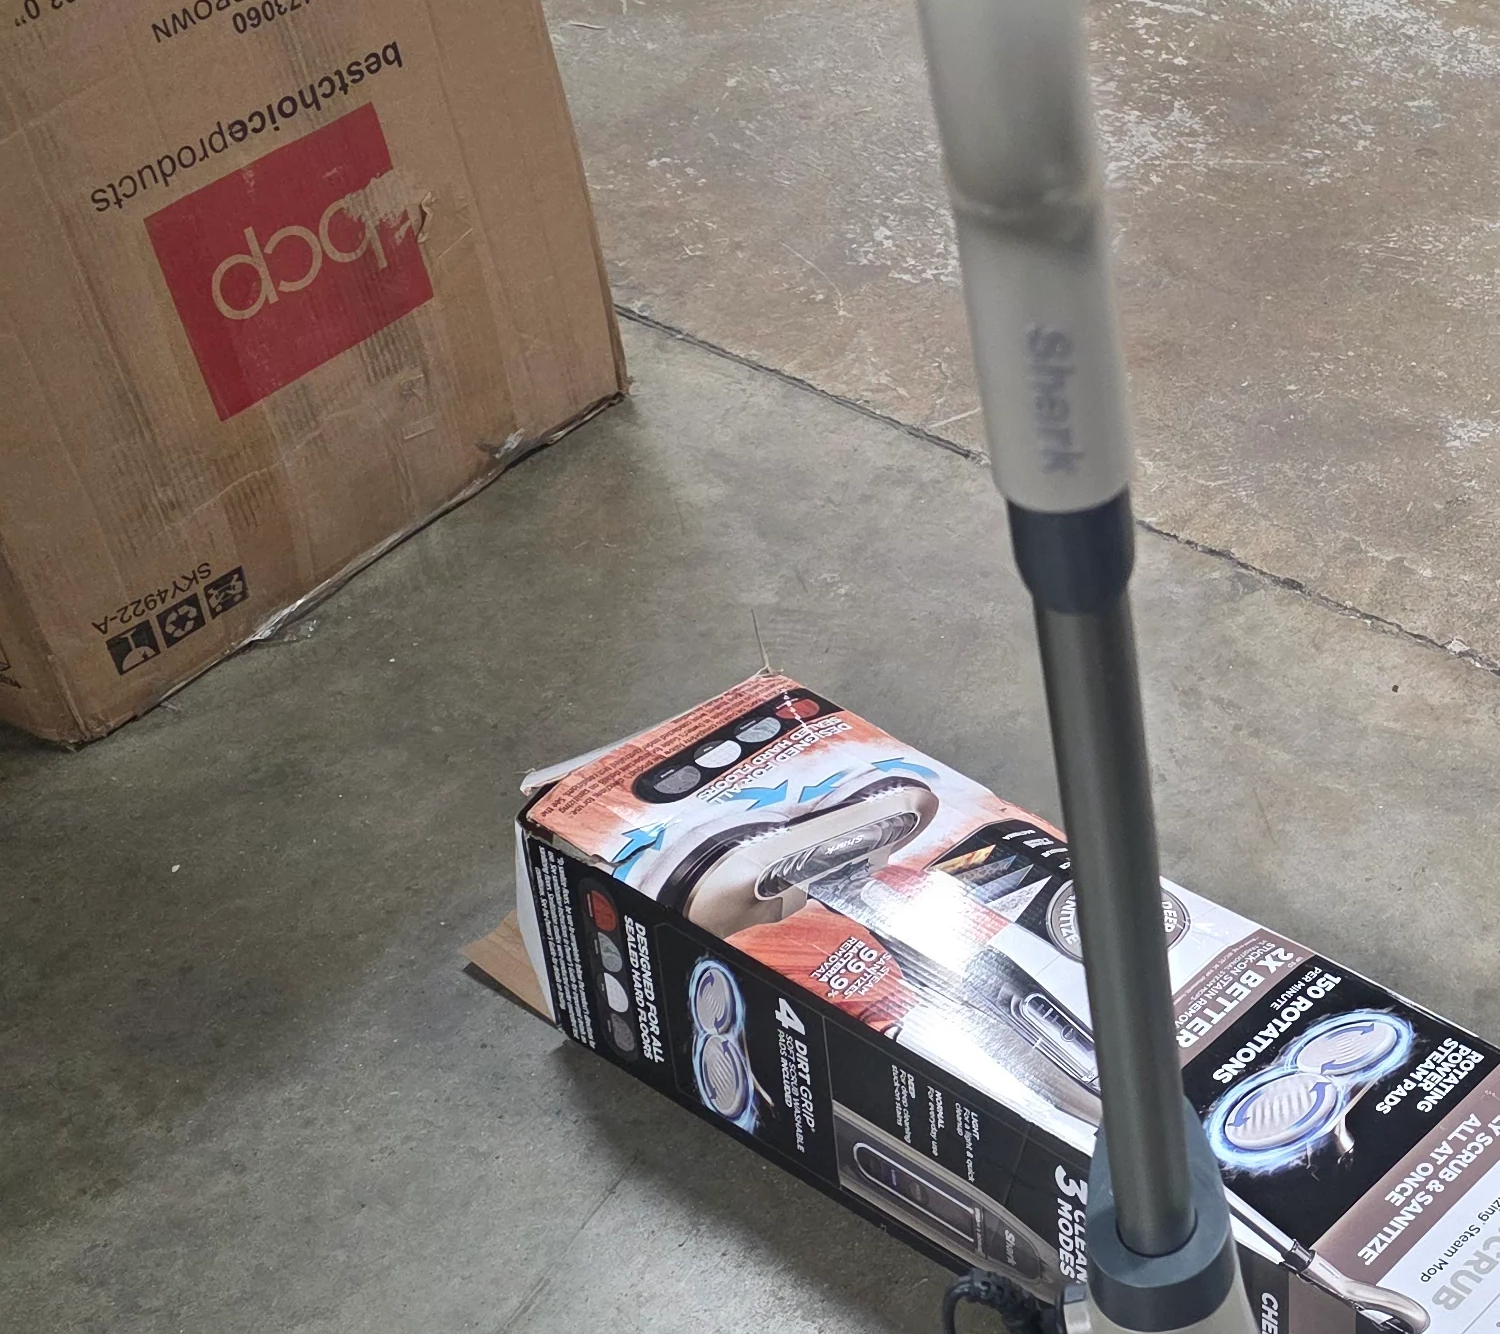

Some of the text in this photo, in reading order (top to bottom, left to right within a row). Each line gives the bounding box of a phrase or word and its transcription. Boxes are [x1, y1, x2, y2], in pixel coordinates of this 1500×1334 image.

[90, 41, 403, 212] bestchoiceproducts
[1023, 327, 1085, 473] Shark
[91, 562, 212, 635] SKY4922-A
[749, 737, 791, 768] HARD
[773, 720, 854, 765] DESIGNED
[695, 763, 751, 801] FLOORS
[706, 782, 741, 807] ALL
[740, 761, 775, 786] FOR
[1059, 895, 1080, 945] NITIZE
[1161, 900, 1179, 933] DEEP
[810, 937, 857, 977] REMOVAL
[818, 940, 865, 983] BACTERIA
[844, 953, 891, 999] SANITIZES
[1232, 942, 1276, 975] STUCK-ON
[1255, 947, 1294, 974] 2X
[623, 915, 653, 1060] SEALED HARD FLOORS
[634, 921, 665, 1063] DESIGNED FOR ALL
[858, 966, 890, 995] STEAM
[1207, 973, 1233, 1000] STAIN
[1269, 967, 1323, 1011] PER MINUTE
[1174, 997, 1208, 1029] REMOV
[1175, 969, 1266, 1048] BETTER
[1212, 972, 1342, 1084] 150 ROTATIONS
[775, 997, 806, 1036] 4
[795, 1039, 811, 1086] DIRT
[777, 1028, 792, 1108] PADS INCLUDED
[907, 1073, 916, 1099] DEEP
[1375, 1037, 1459, 1115] STEAM PADS
[1417, 1051, 1485, 1113] ROTATING
[1418, 1044, 1472, 1091] POWER
[785, 1033, 805, 1153] SOFT SCRUB WASHABLE
[935, 1090, 944, 1128] NORMAL
[971, 1111, 980, 1141] LIGHT
[1384, 1113, 1482, 1207] ALL AT ONCE
[1438, 1132, 1493, 1183] SCRUB
[1425, 1178, 1445, 1193] &
[1054, 1164, 1088, 1284] 3 CLEAN
[1057, 1198, 1075, 1279] MODES
[1357, 1191, 1434, 1266] SANITIZE
[1443, 1223, 1482, 1260] Steam
[1005, 1229, 1016, 1266] Shark
[1420, 1258, 1449, 1283] Mop
